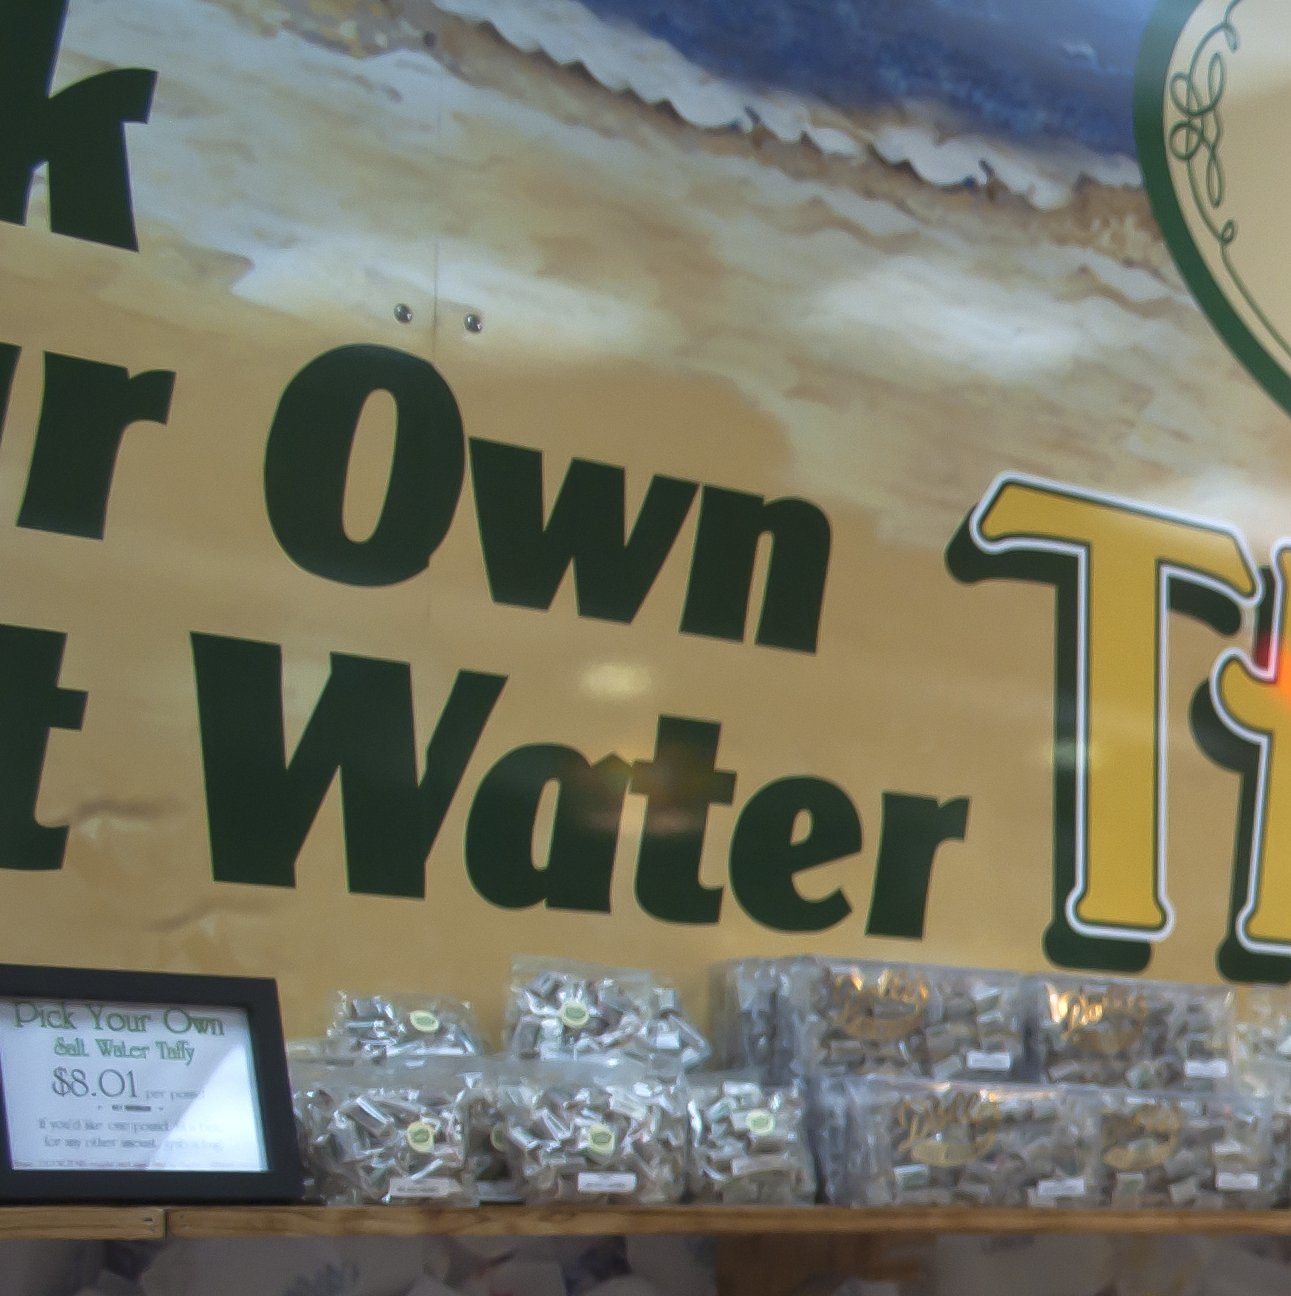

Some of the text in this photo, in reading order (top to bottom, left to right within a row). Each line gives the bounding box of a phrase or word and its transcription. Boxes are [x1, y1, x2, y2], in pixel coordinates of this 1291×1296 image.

[0, 343, 831, 655] r Own
[190, 631, 970, 941] Water
[14, 1001, 224, 1036] Pick Your Own
[54, 1037, 195, 1066] Salt Water Taffy
[52, 1066, 138, 1098] $8.01
